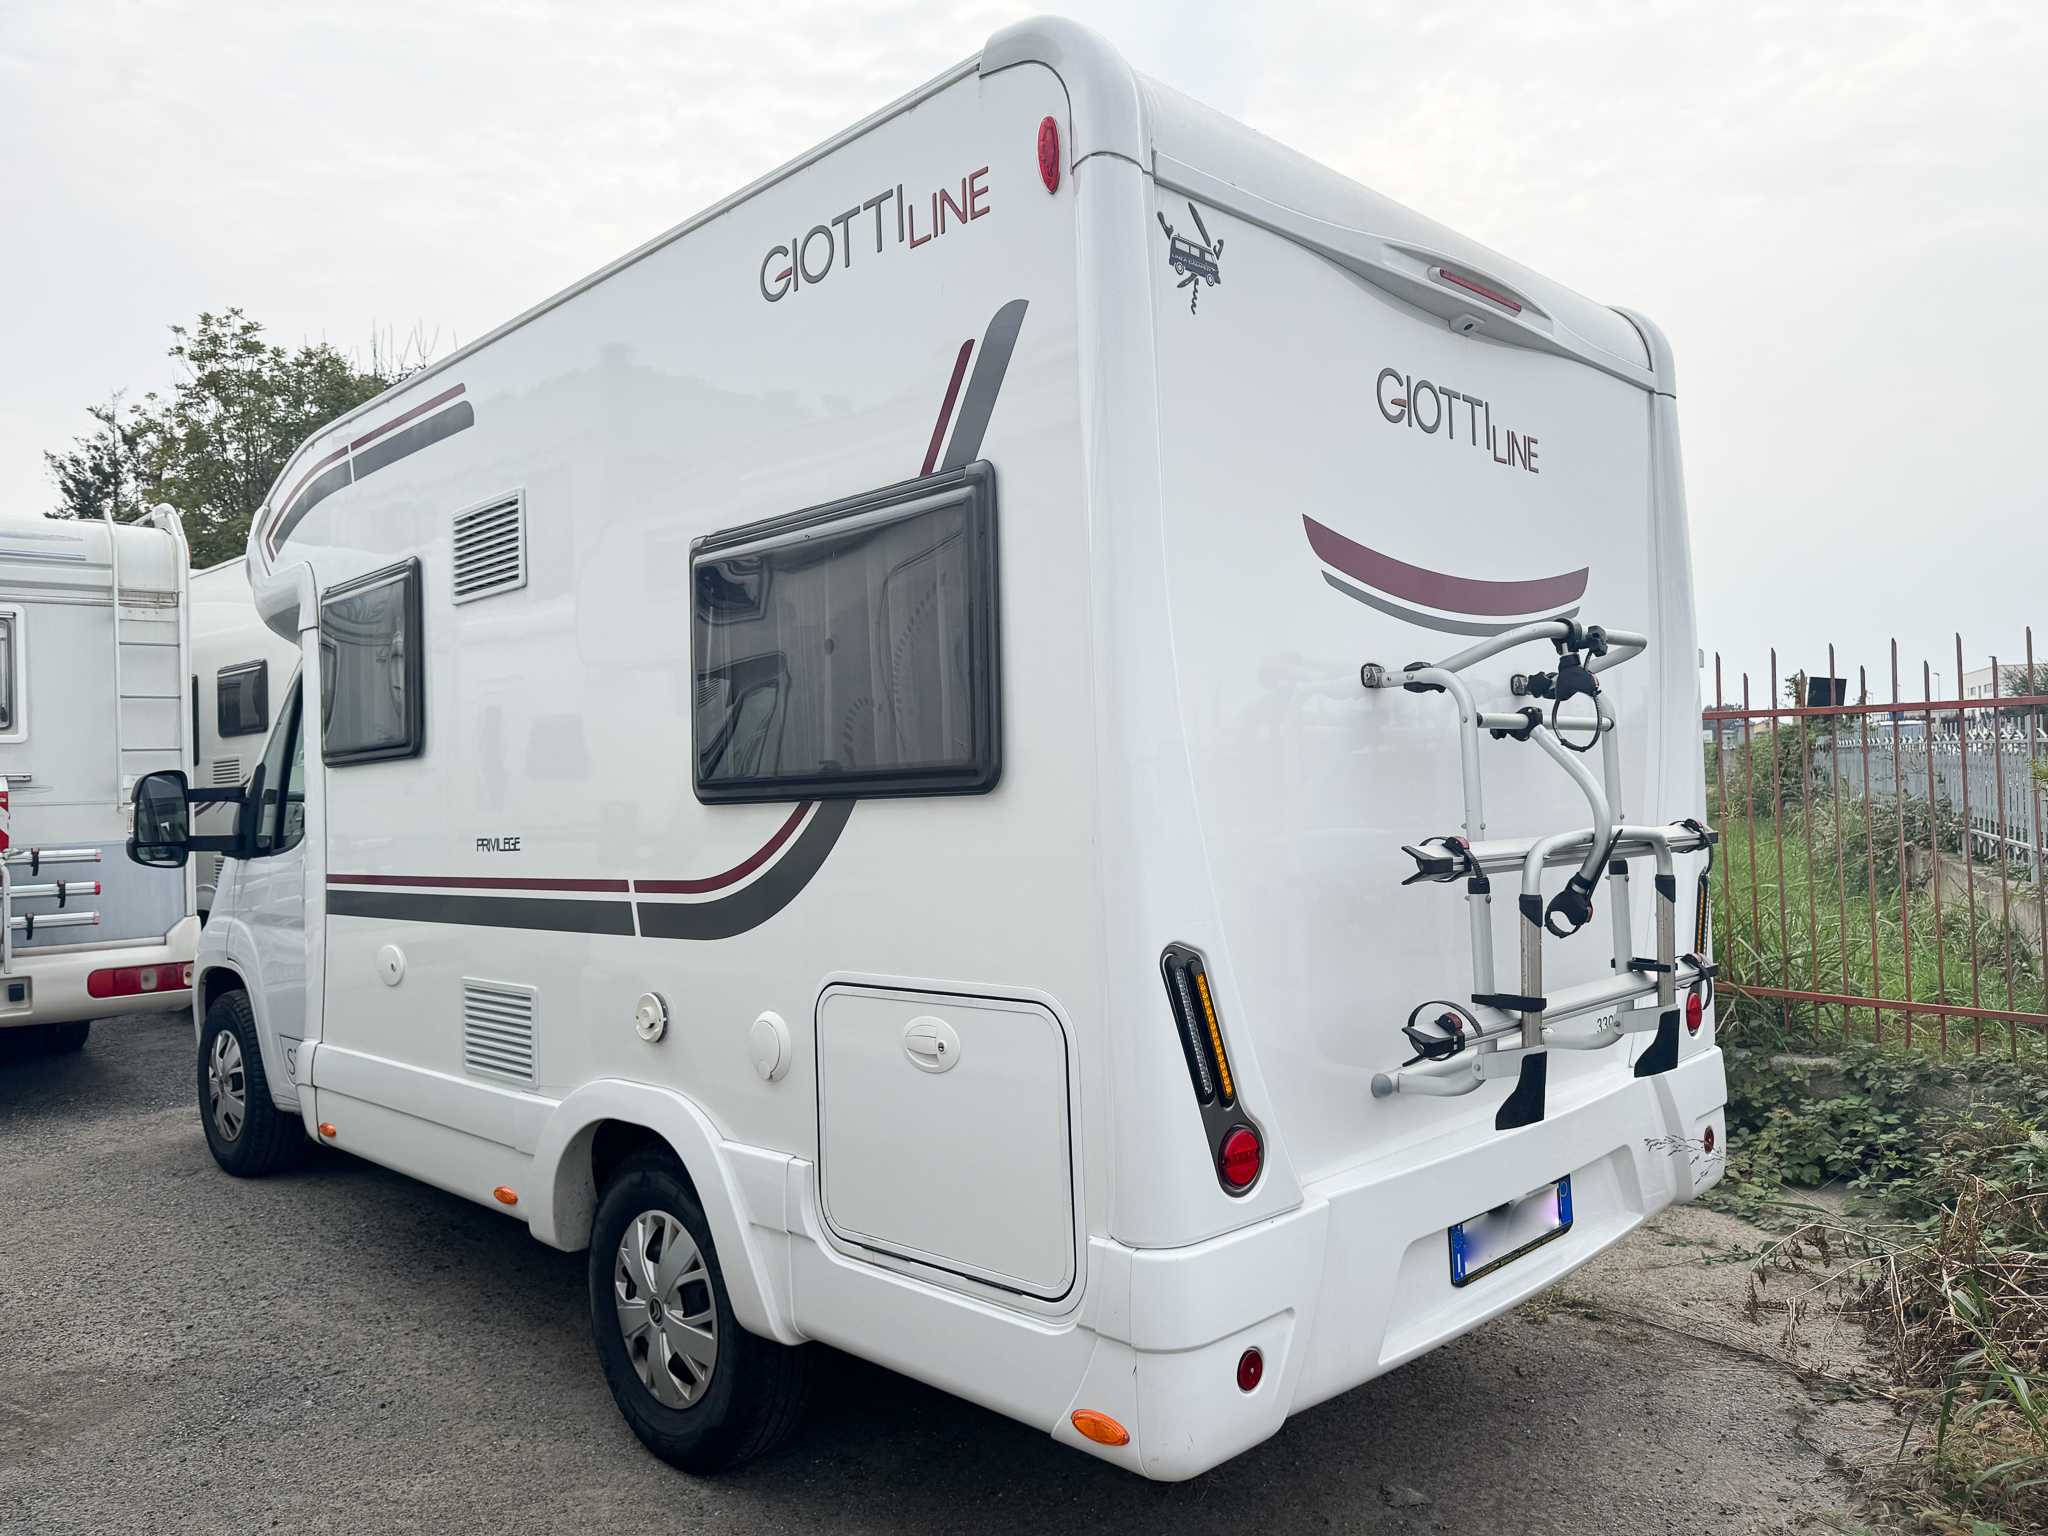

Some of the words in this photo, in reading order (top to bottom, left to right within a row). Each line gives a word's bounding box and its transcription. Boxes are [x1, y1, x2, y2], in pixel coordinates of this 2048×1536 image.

[760, 166, 990, 303] GIOTTILINE
[1376, 367, 1539, 474] GIOTTILINE
[476, 836, 521, 853] PRIVILEGE
